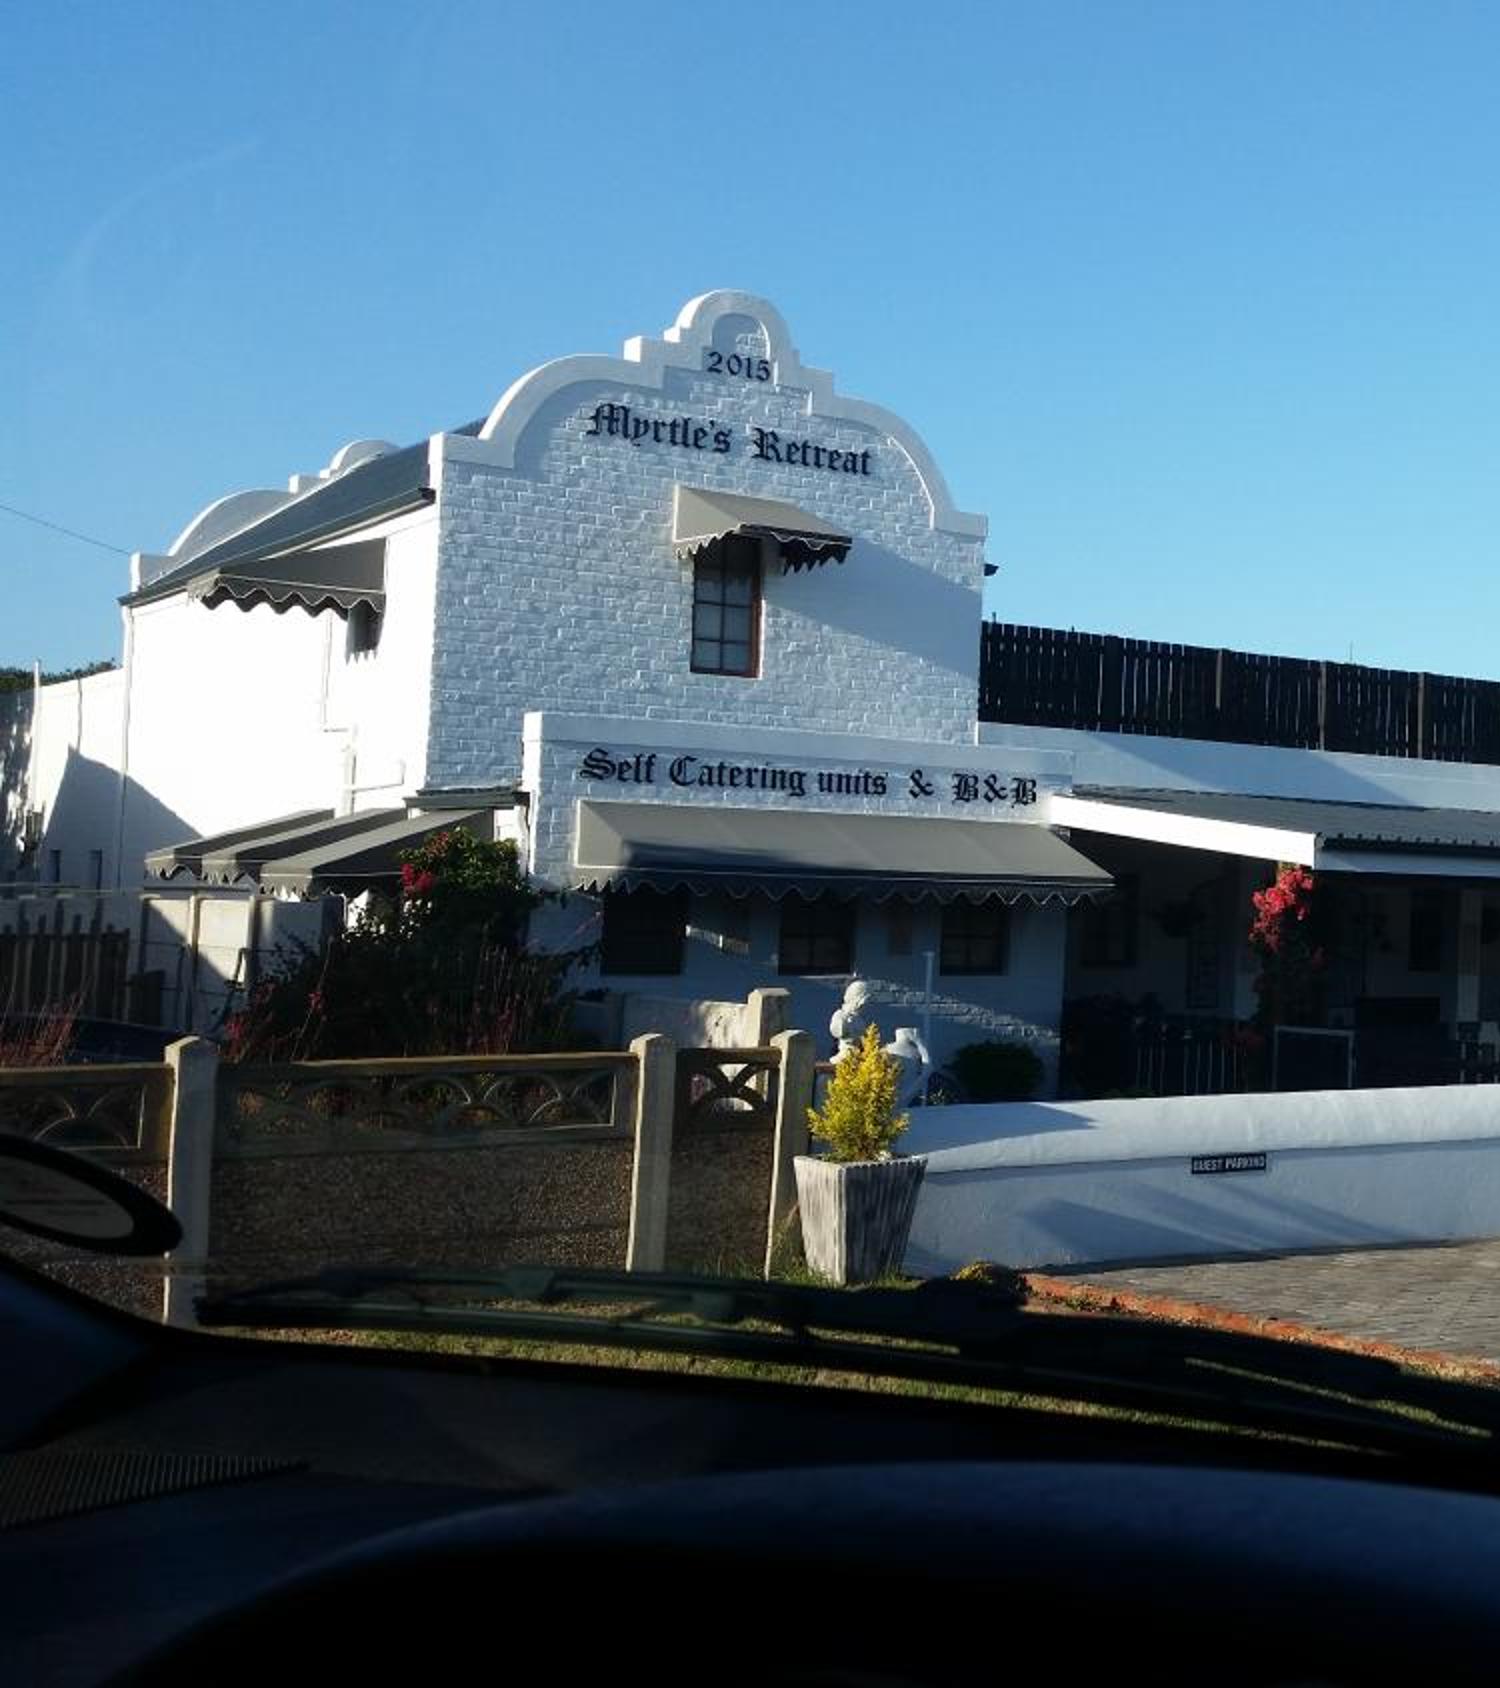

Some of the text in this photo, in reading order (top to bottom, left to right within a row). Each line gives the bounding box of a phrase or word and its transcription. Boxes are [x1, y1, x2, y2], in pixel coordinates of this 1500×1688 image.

[706, 350, 771, 383] 2015
[586, 402, 872, 476] Myrtle's Retreat
[579, 747, 1038, 808] Self Catering units & B&B
